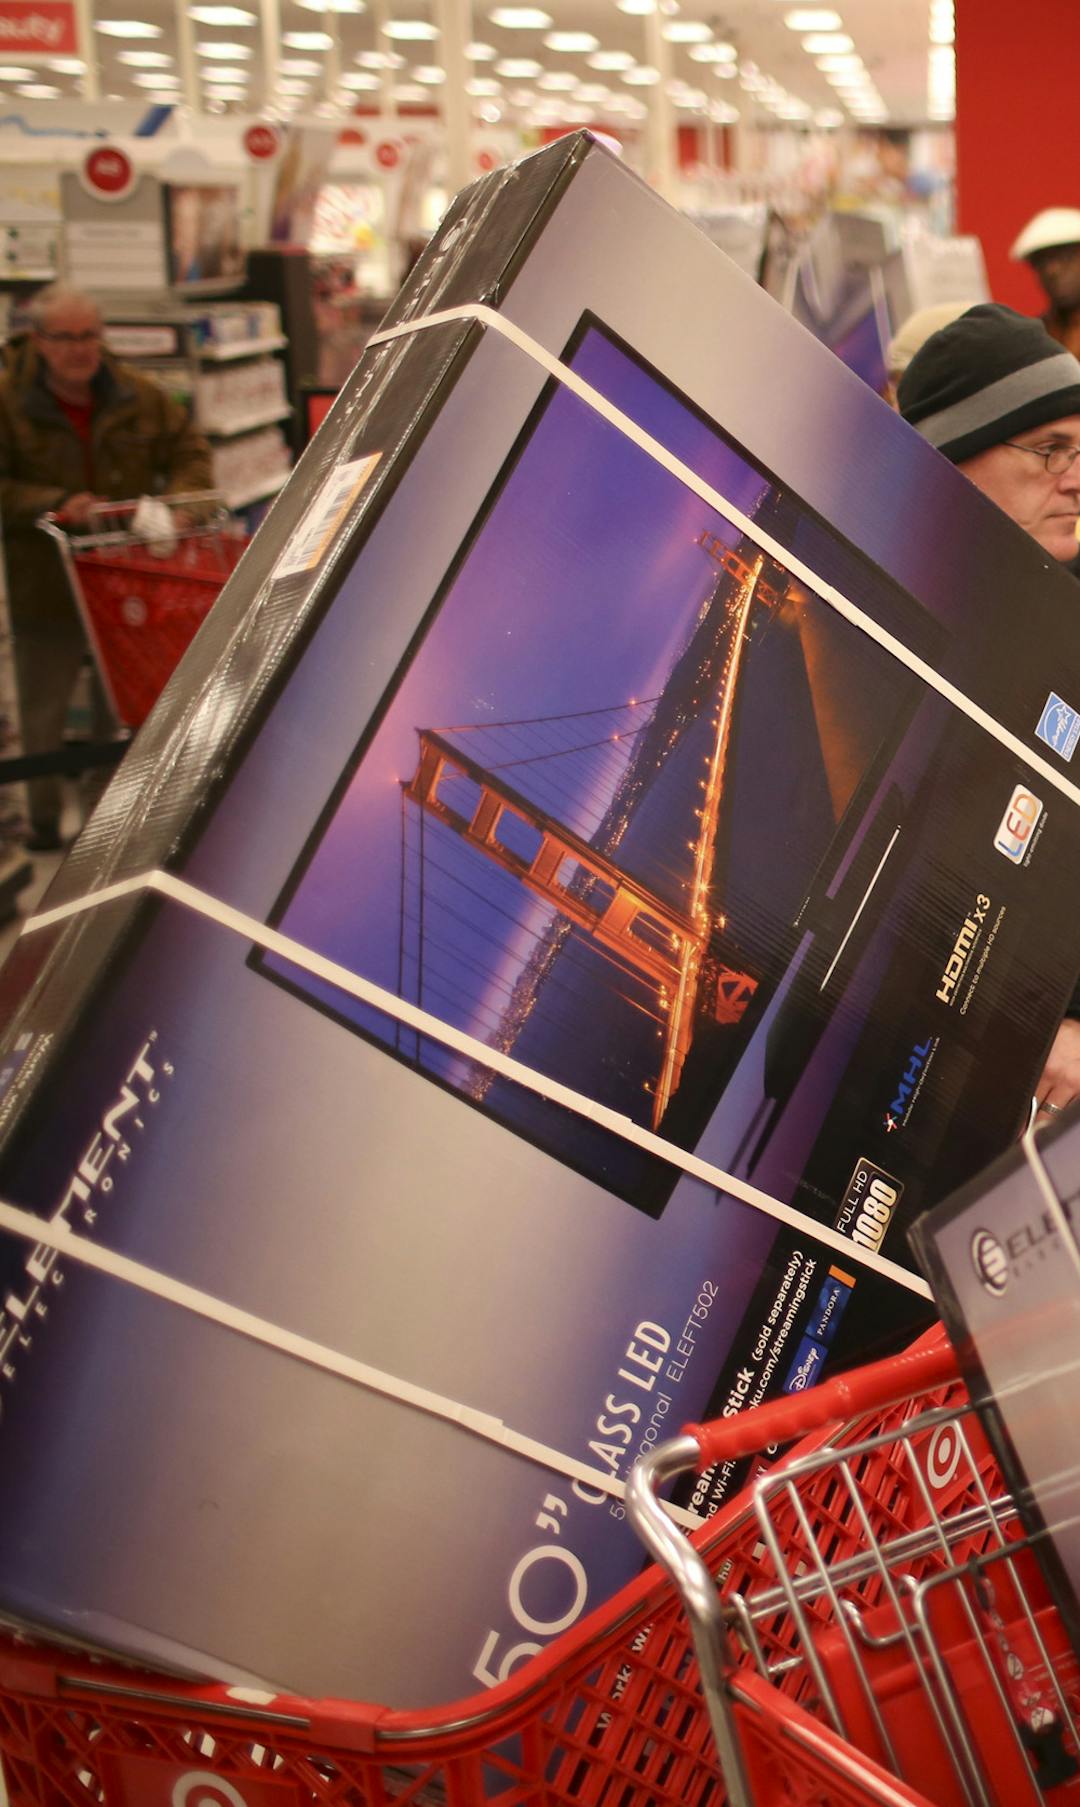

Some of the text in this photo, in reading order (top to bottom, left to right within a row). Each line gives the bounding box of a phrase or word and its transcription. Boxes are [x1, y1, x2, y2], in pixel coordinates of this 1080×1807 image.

[998, 793, 1038, 857] LED
[936, 918, 979, 1004] HDMI
[960, 985, 976, 1015] Connect
[972, 974, 980, 985] to
[977, 945, 991, 974] multiple
[987, 934, 995, 945] HD
[992, 905, 1006, 934] sources
[890, 1039, 932, 1114] MHL
[2, 1060, 175, 1383] ELECRONICS
[837, 1170, 868, 1233] FULL HD
[851, 1178, 898, 1250] 1080
[666, 1279, 720, 1383] ELEFT502
[722, 1367, 756, 1418] Stick
[752, 1325, 773, 1361] (sold
[767, 1250, 804, 1326] separately)
[817, 1288, 841, 1336] PANDORA
[618, 1320, 672, 1392] LED
